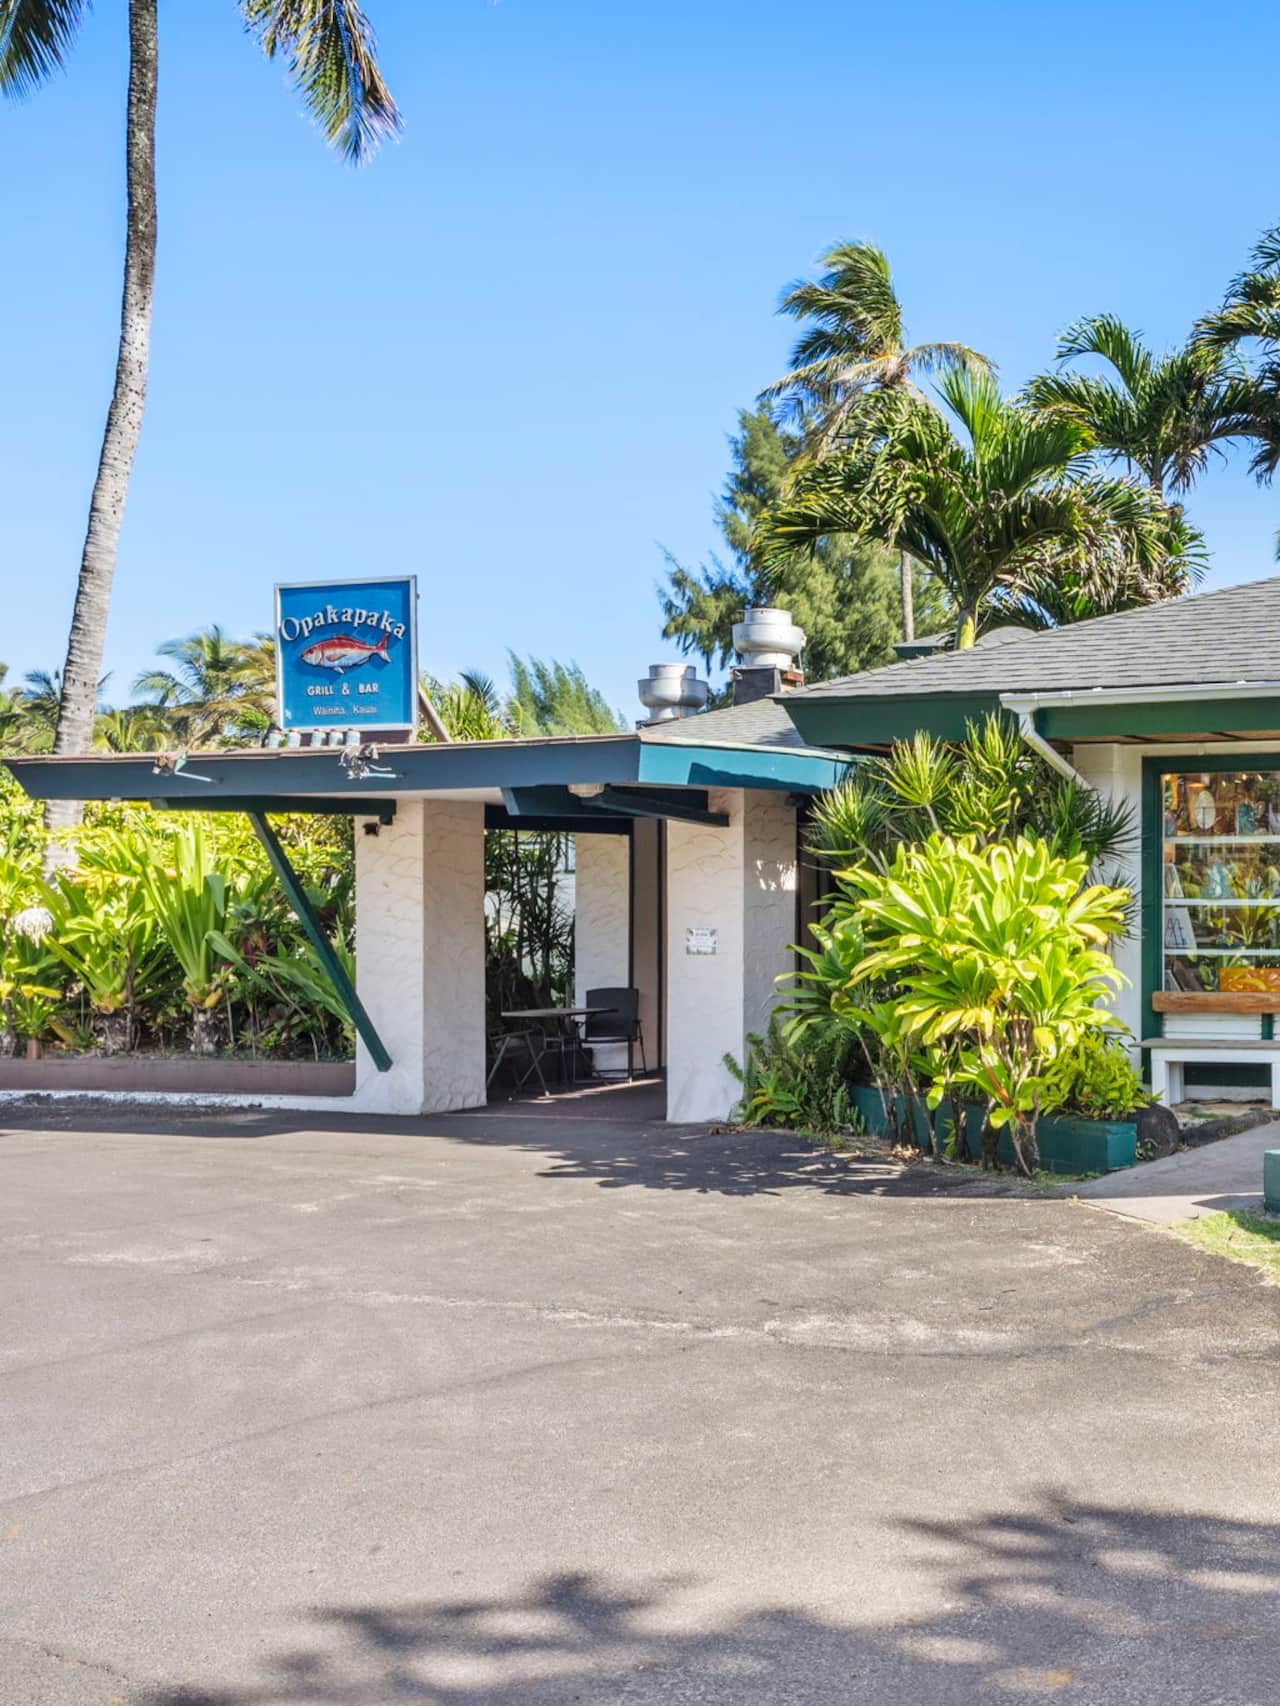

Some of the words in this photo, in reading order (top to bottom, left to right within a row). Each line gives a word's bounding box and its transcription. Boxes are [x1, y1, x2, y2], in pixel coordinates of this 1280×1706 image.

[281, 605, 406, 641] Opakapaka
[307, 685, 335, 696] GRILL
[342, 682, 350, 695] &
[358, 682, 379, 694] BAR
